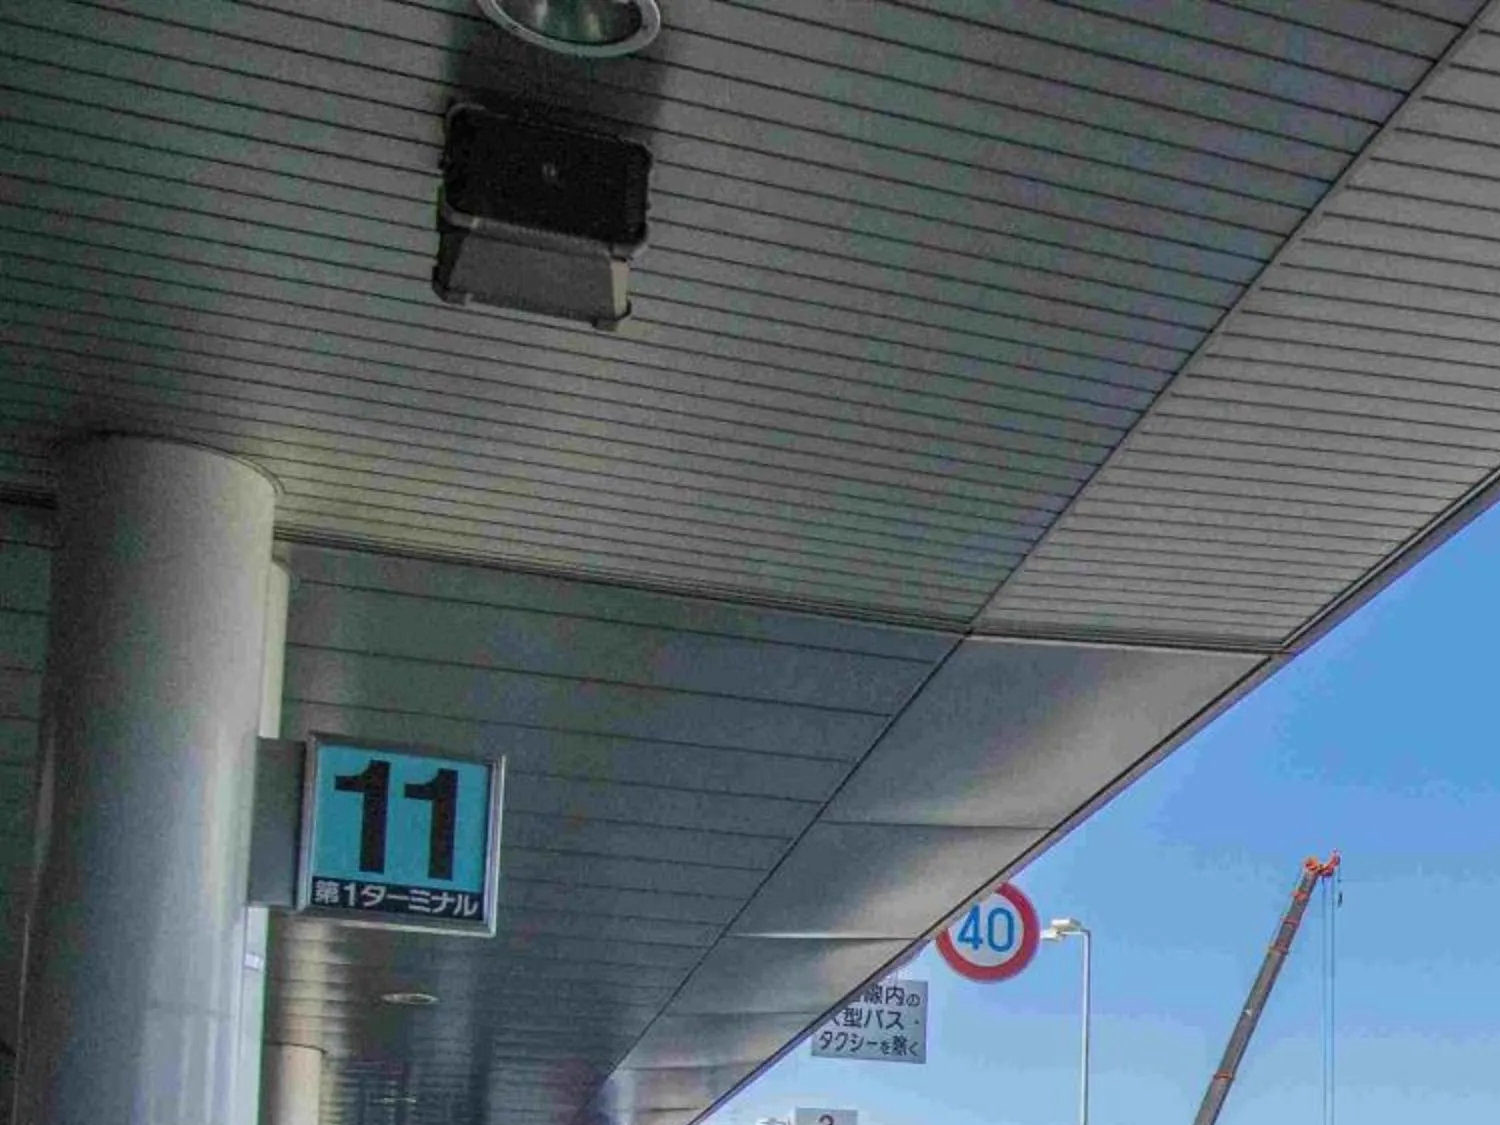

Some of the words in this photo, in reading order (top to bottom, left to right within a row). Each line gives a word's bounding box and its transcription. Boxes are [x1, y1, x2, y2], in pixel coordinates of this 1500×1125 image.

[334, 759, 459, 881] 11
[313, 880, 479, 917] 第1ターミナル
[957, 903, 1014, 952] 40
[818, 1030, 920, 1058] タクシーを除く
